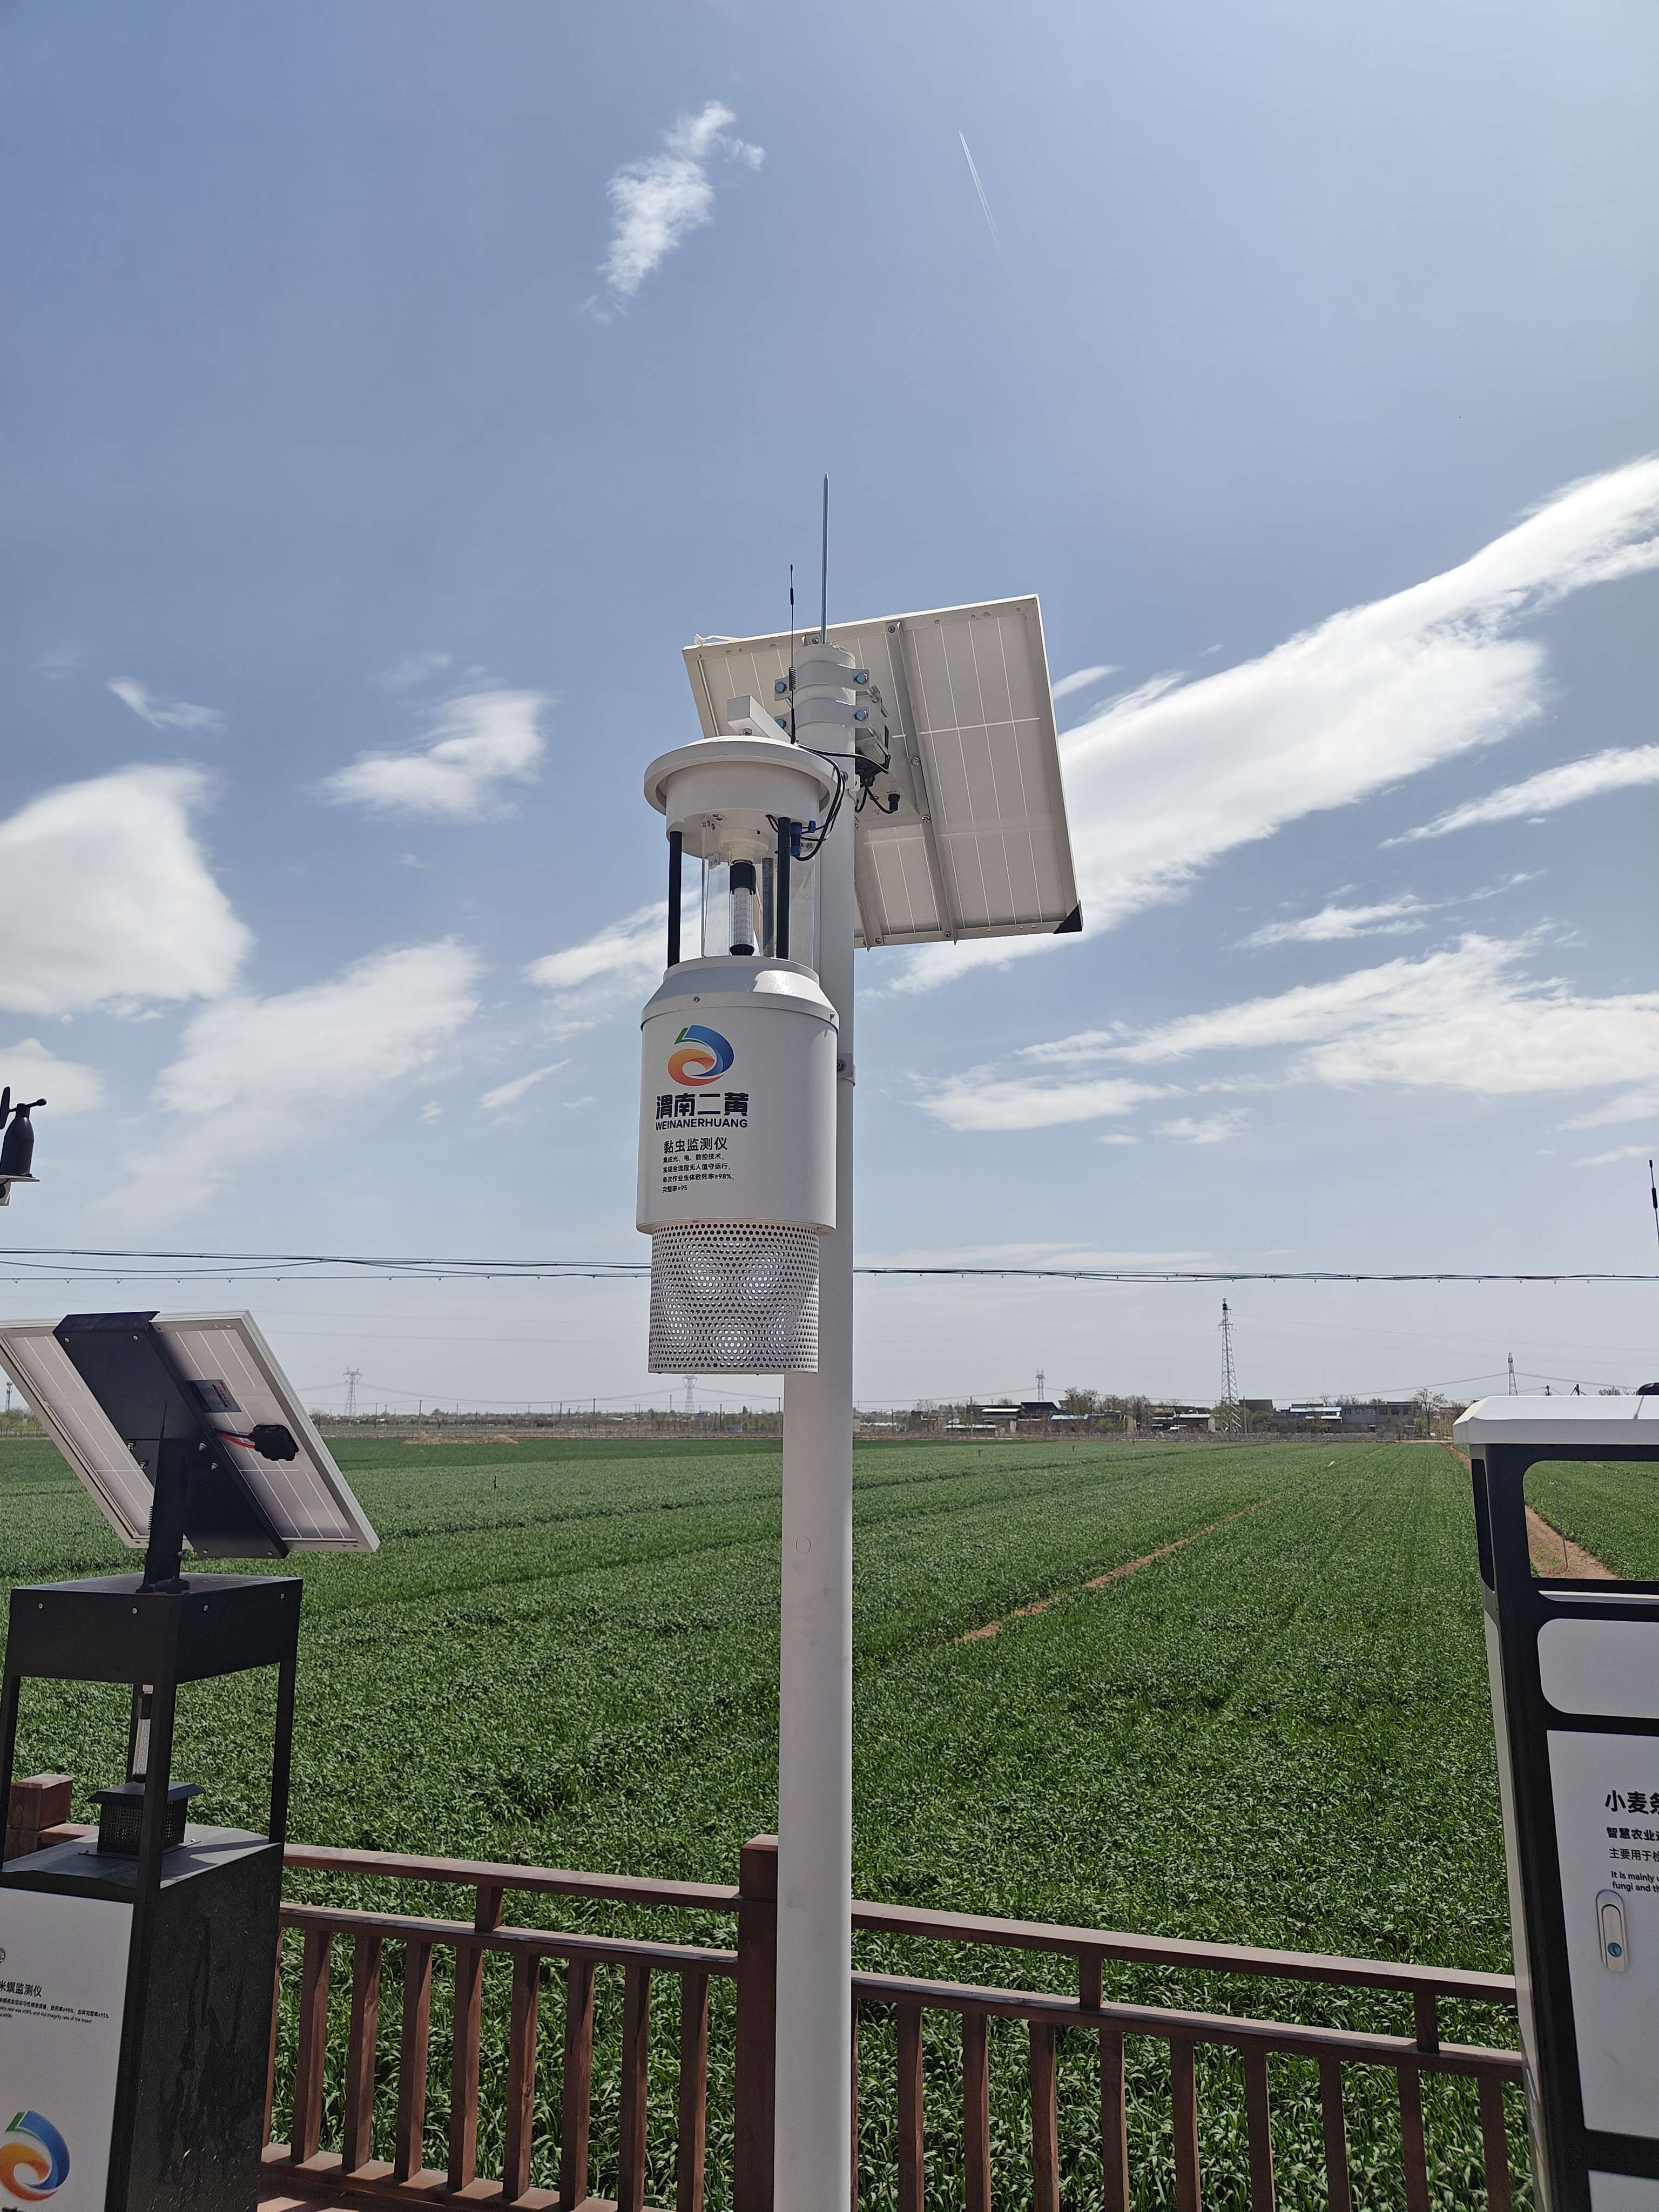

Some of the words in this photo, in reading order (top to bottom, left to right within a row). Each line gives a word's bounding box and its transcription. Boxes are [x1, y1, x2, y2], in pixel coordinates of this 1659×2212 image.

[656, 1092, 749, 1120] 渭南二黄
[656, 1118, 748, 1130] WEINANERHUANG
[663, 1137, 728, 1154] 黏虫监测仪
[1611, 1871, 1618, 1879] It
[1619, 1871, 1626, 1879] is
[1628, 1873, 1655, 1883] mainly
[1612, 1881, 1634, 1892] fungi
[1635, 1884, 1651, 1892] and
